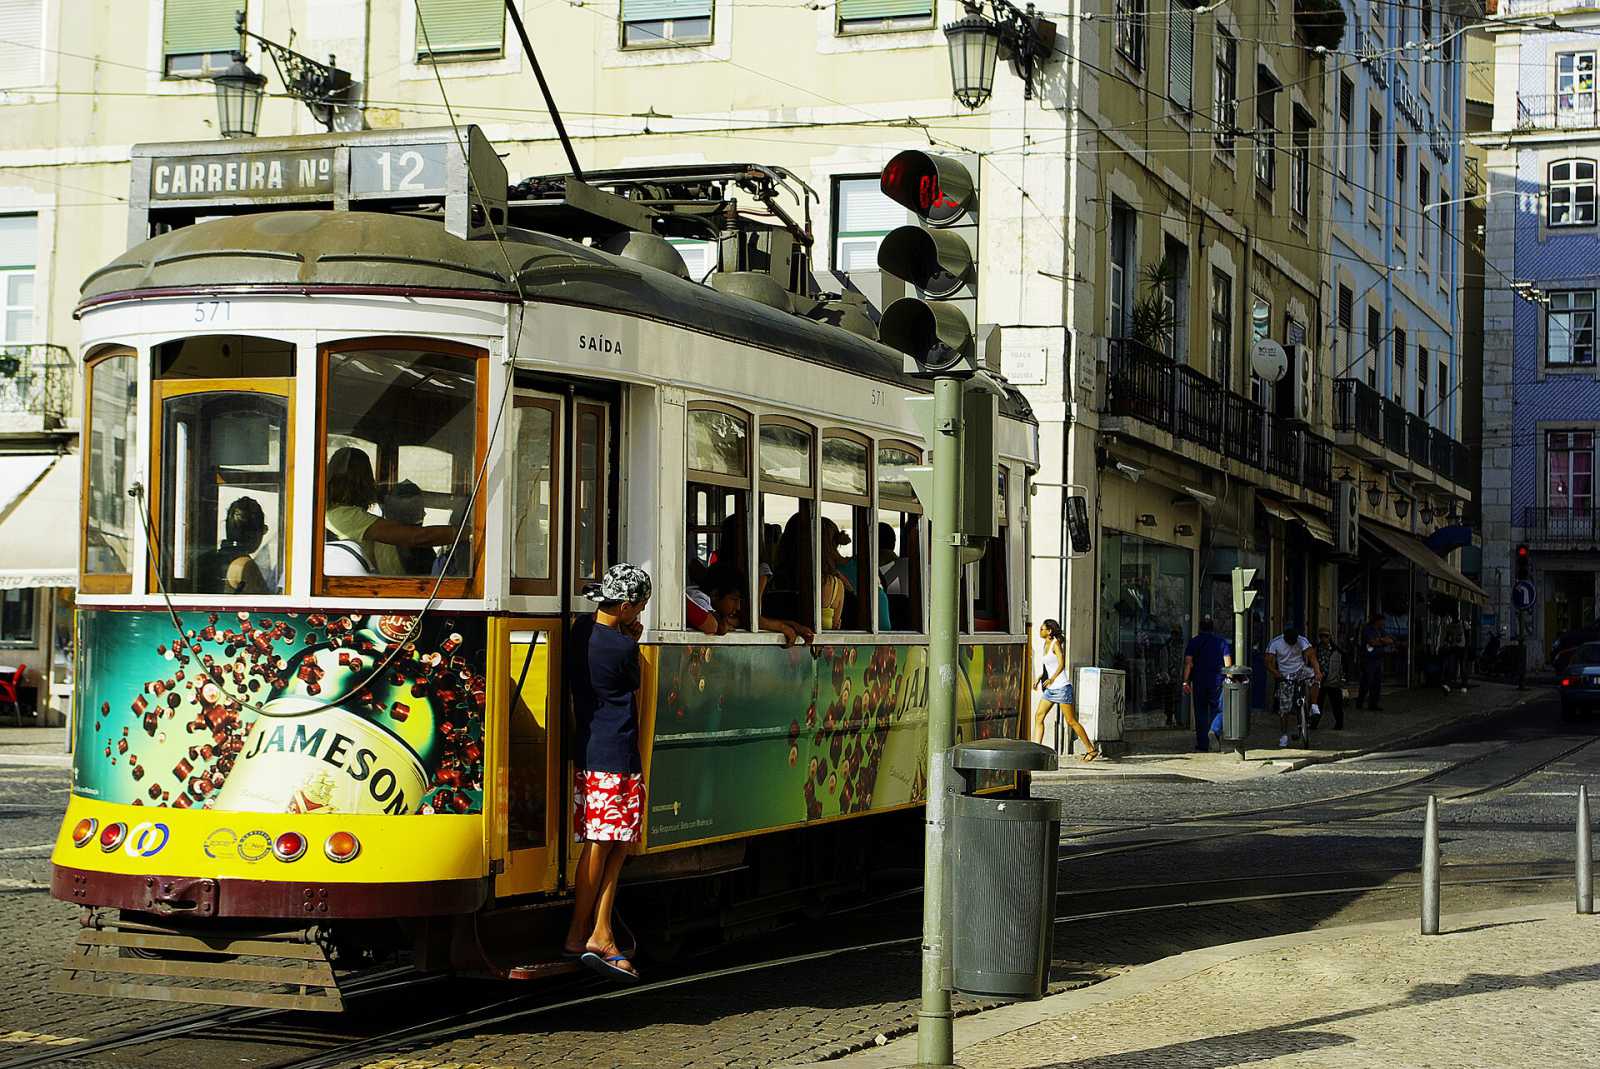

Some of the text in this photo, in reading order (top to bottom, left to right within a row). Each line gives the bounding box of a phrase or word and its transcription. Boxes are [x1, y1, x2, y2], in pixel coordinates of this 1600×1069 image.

[154, 160, 283, 194] CARREIRA
[376, 150, 425, 191] 12
[194, 301, 231, 322] 571
[579, 334, 622, 355] SAÍDA
[871, 388, 886, 408] 571
[245, 724, 409, 815] JAMESON
